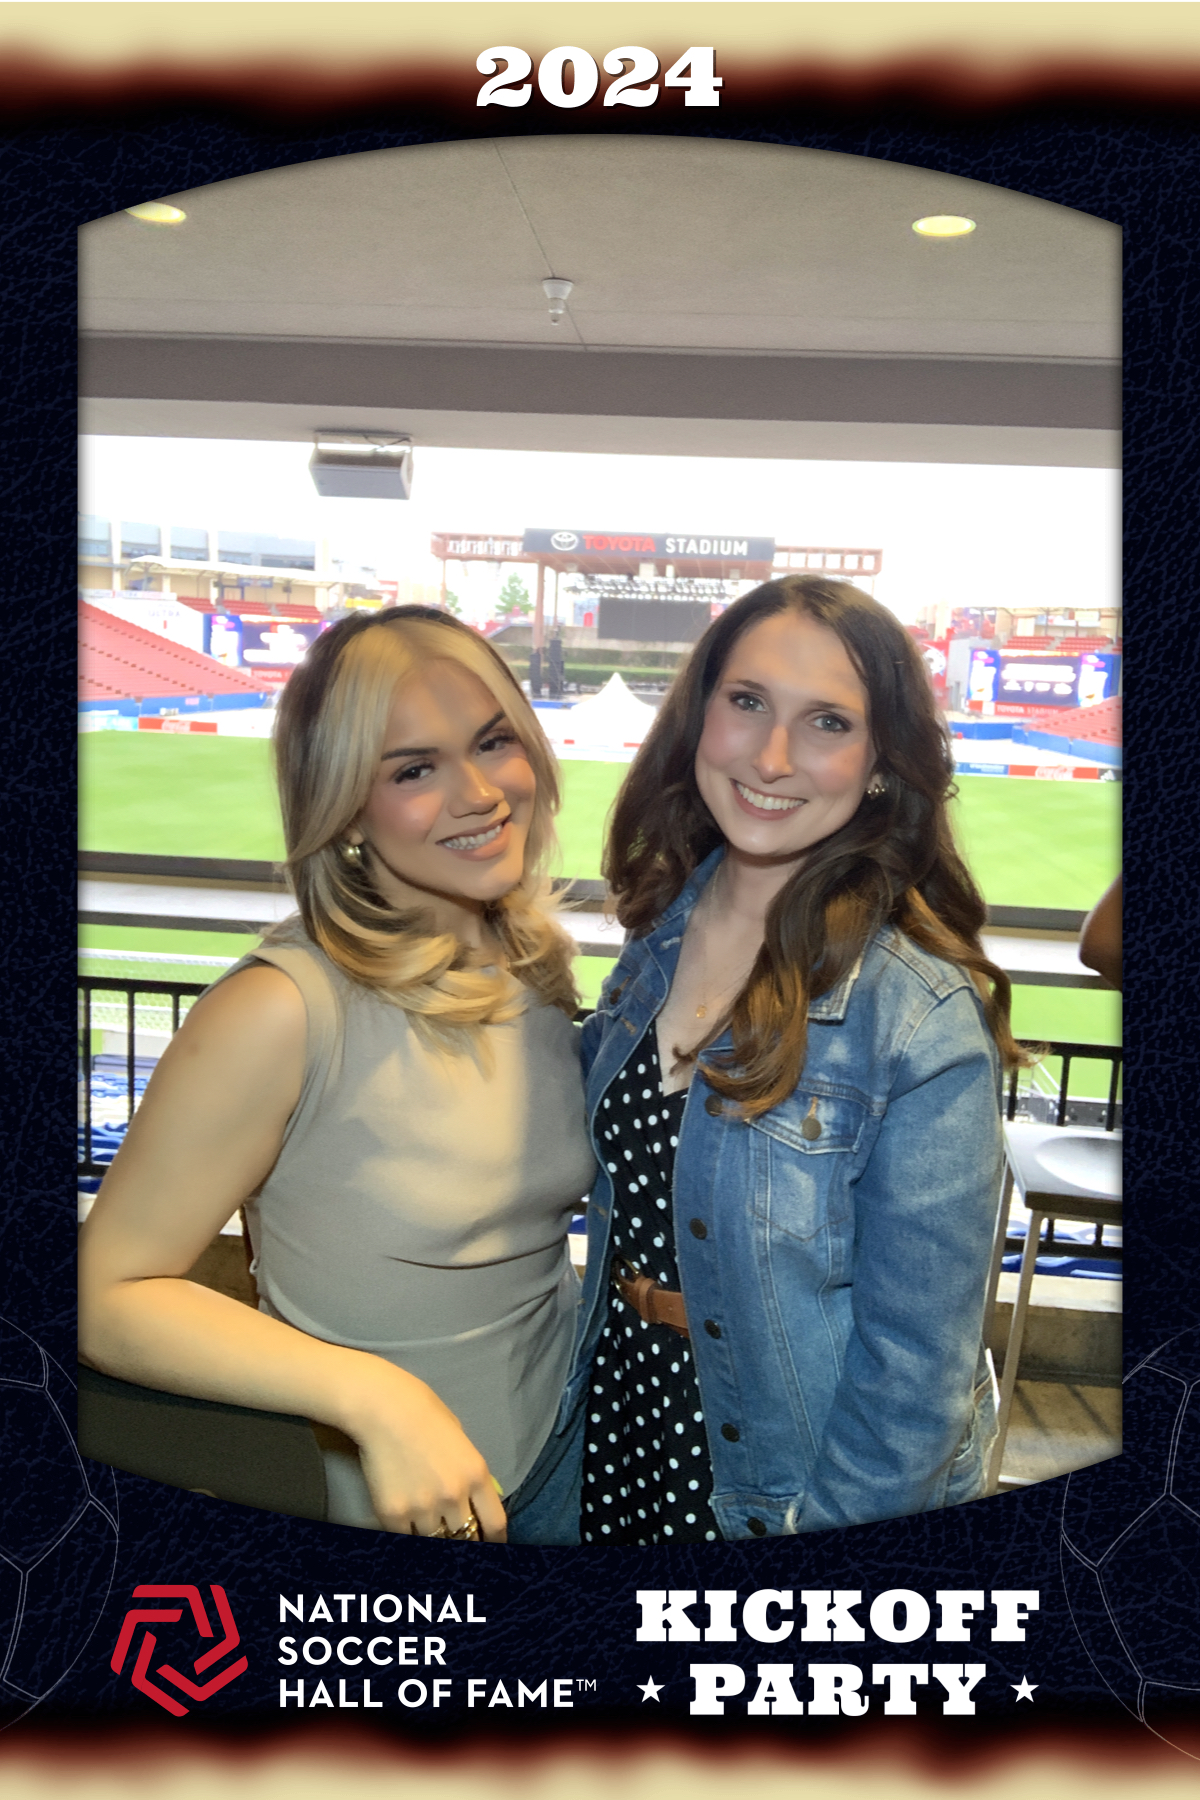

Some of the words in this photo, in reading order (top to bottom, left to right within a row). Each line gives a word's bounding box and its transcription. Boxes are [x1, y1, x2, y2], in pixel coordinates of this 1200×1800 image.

[583, 534, 656, 552] TOYOTA
[665, 537, 748, 556] STADIUM
[996, 704, 1025, 714] TOYOTA
